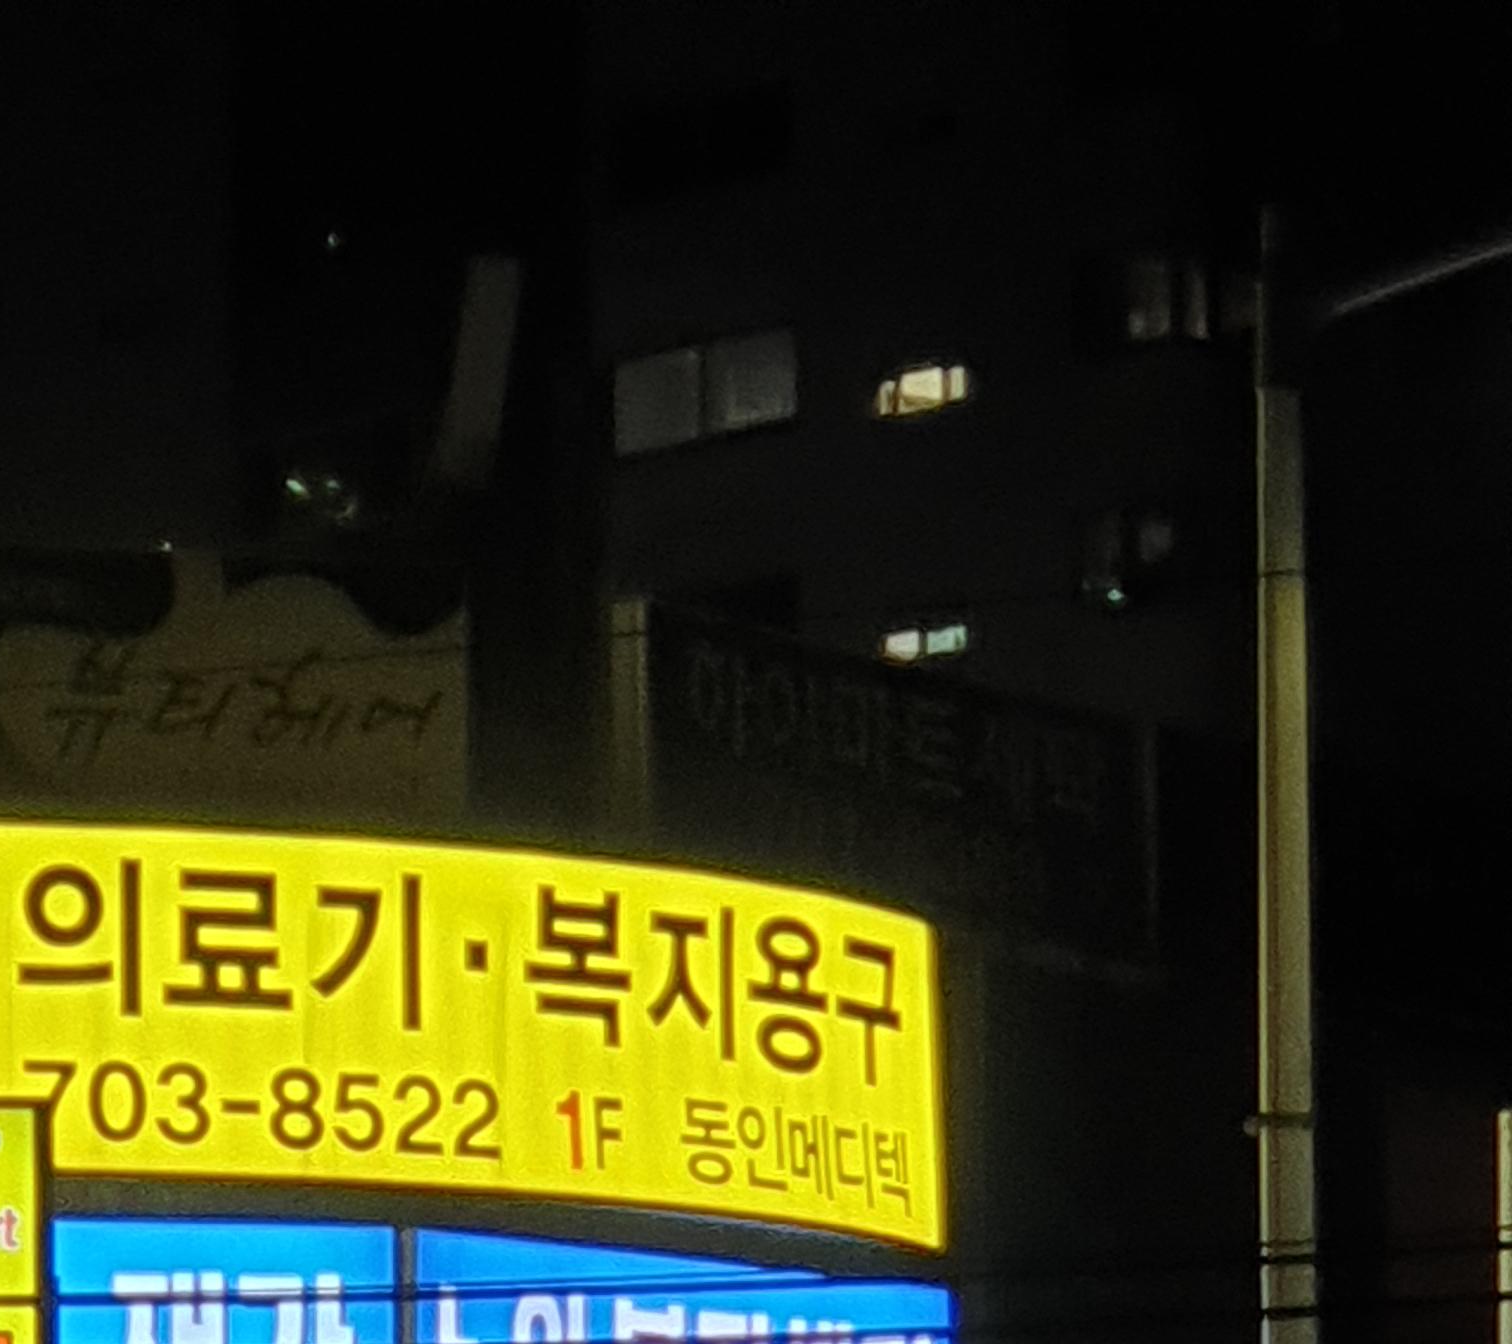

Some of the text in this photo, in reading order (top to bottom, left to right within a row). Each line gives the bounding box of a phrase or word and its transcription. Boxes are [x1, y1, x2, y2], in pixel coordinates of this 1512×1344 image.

[22, 1060, 914, 1218] 703-8522 1F 동인메디텍
